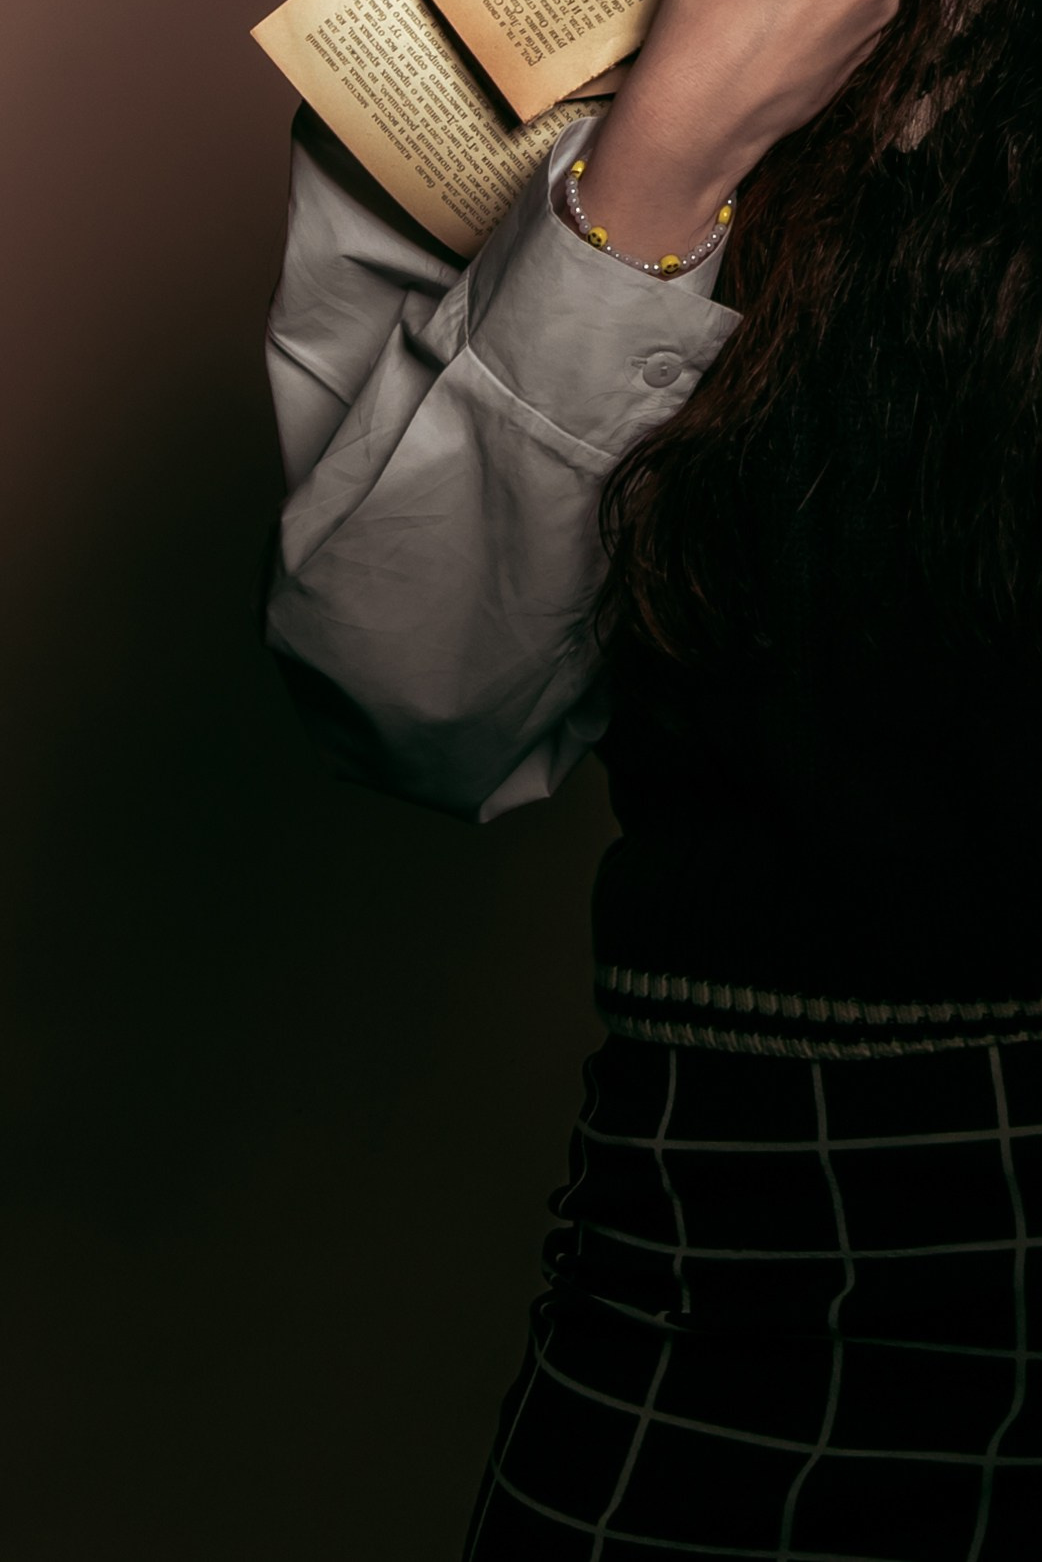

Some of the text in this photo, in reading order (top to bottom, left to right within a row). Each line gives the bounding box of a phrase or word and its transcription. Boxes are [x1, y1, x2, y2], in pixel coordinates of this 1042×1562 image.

[361, 10, 386, 38] отели
[387, 22, 404, 39] тут
[303, 30, 342, 74] свиданий
[383, 36, 398, 53] все
[396, 52, 406, 62] и
[403, 60, 419, 78] как
[340, 75, 370, 109] местом
[427, 71, 468, 120] известного
[314, 23, 487, 227] только для неопытных и восторженных девчонок,
[370, 110, 414, 161] идеальным
[467, 120, 501, 158] людьми
[412, 163, 437, 190] было
